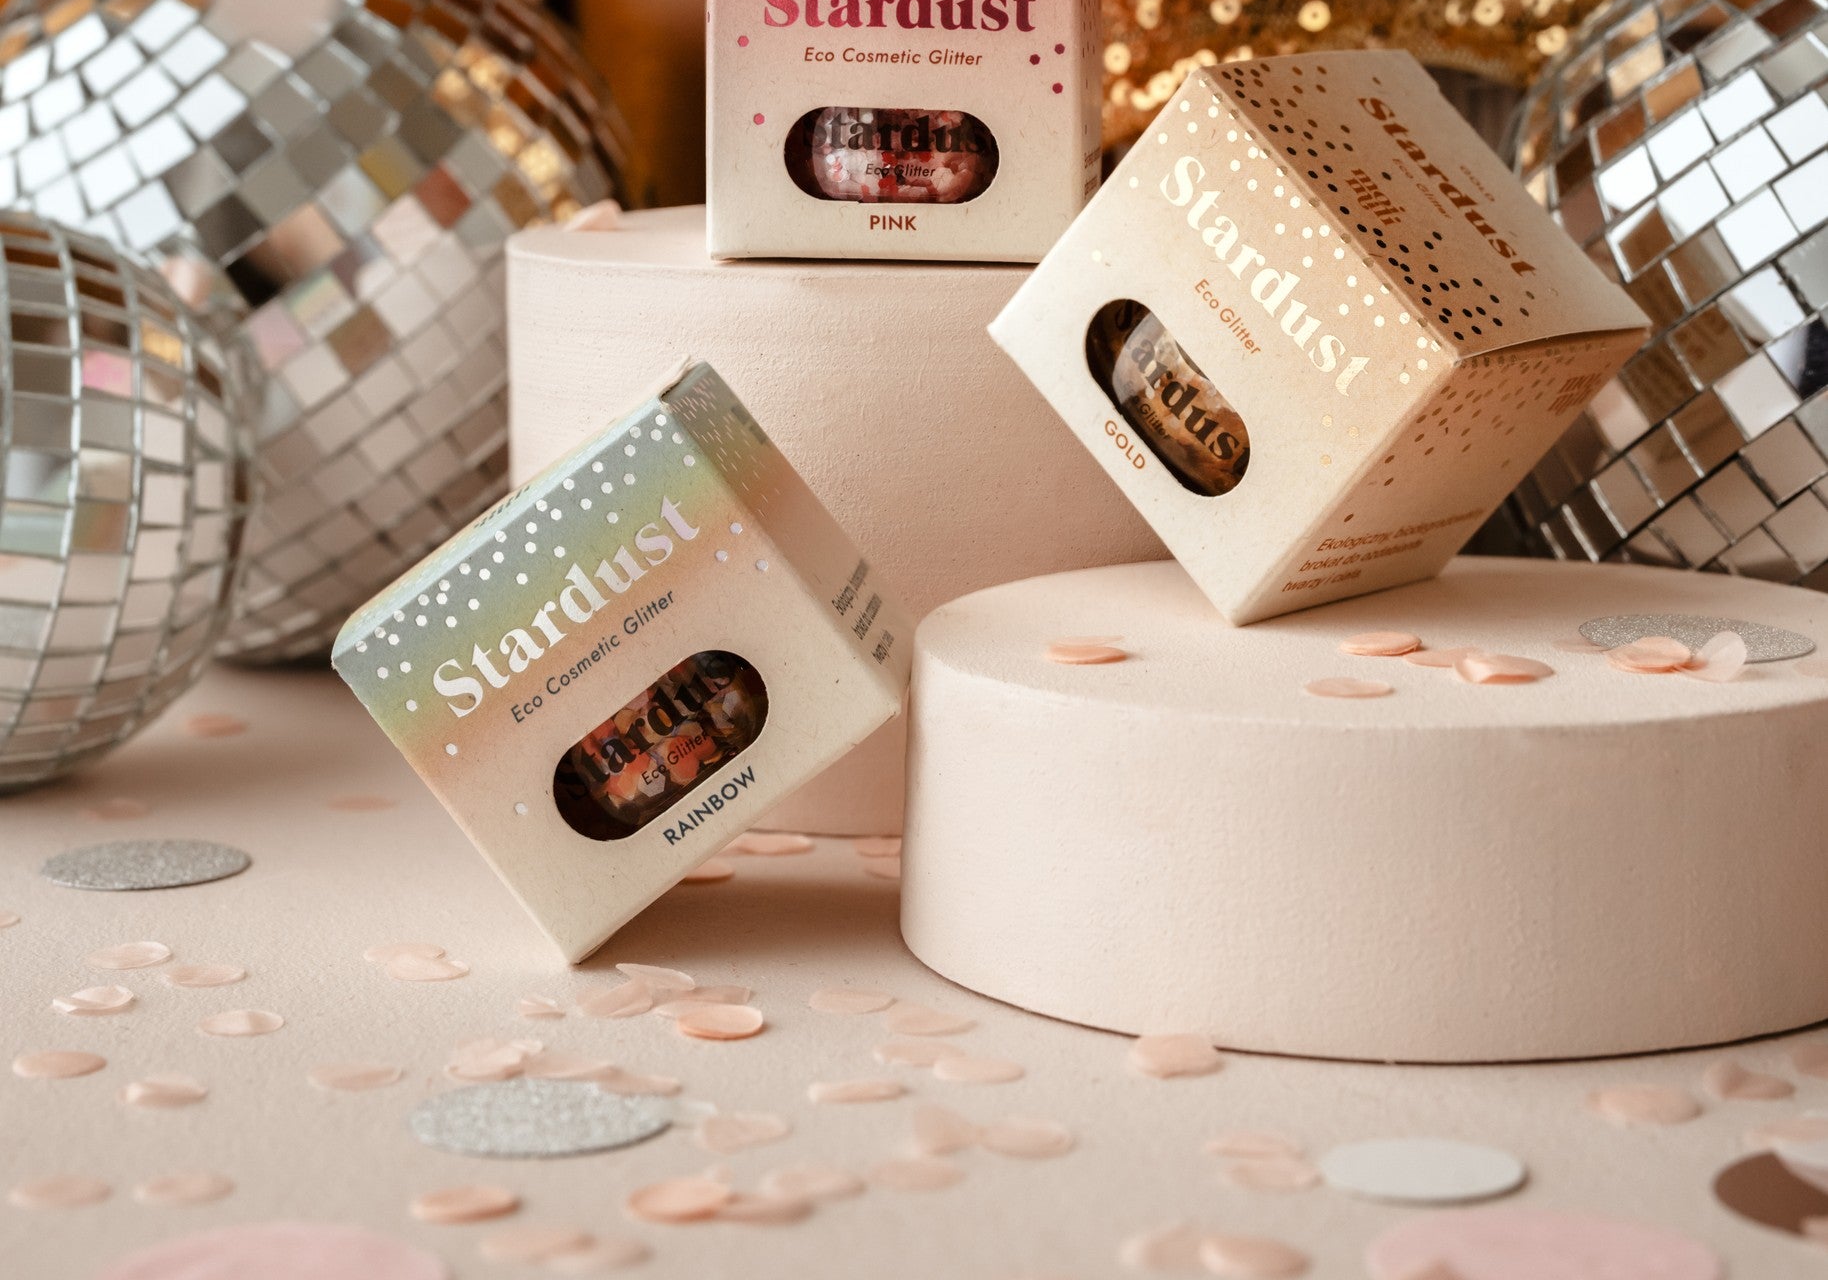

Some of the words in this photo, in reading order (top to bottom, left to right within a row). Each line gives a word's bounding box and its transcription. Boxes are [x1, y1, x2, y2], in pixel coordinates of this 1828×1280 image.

[804, 47, 835, 62] Eco
[842, 48, 921, 64] Cosmetic
[929, 49, 982, 65] Glitter
[803, 113, 992, 153] Stardus
[865, 164, 889, 176] Eco
[894, 164, 936, 177] Glitter
[1358, 97, 1537, 277] Stardust
[1392, 158, 1413, 179] Eco
[1416, 183, 1451, 219] Glitter
[869, 215, 917, 231] PINK
[1159, 156, 1370, 397] Stardust
[1194, 278, 1219, 310] Eco
[1219, 307, 1261, 355] Glitter
[1104, 420, 1146, 470] GOLD
[1139, 403, 1170, 440] Glitter
[1299, 556, 1344, 572] brokat
[1342, 551, 1361, 565] do
[432, 494, 700, 718] Stardust
[510, 695, 543, 723] Eco
[546, 634, 621, 695] Cosmetic
[623, 590, 674, 635] Glitter
[557, 651, 740, 800] Stardus
[641, 763, 668, 786] Eco
[667, 728, 708, 766] Glitter
[662, 765, 755, 845] RAINBOW
